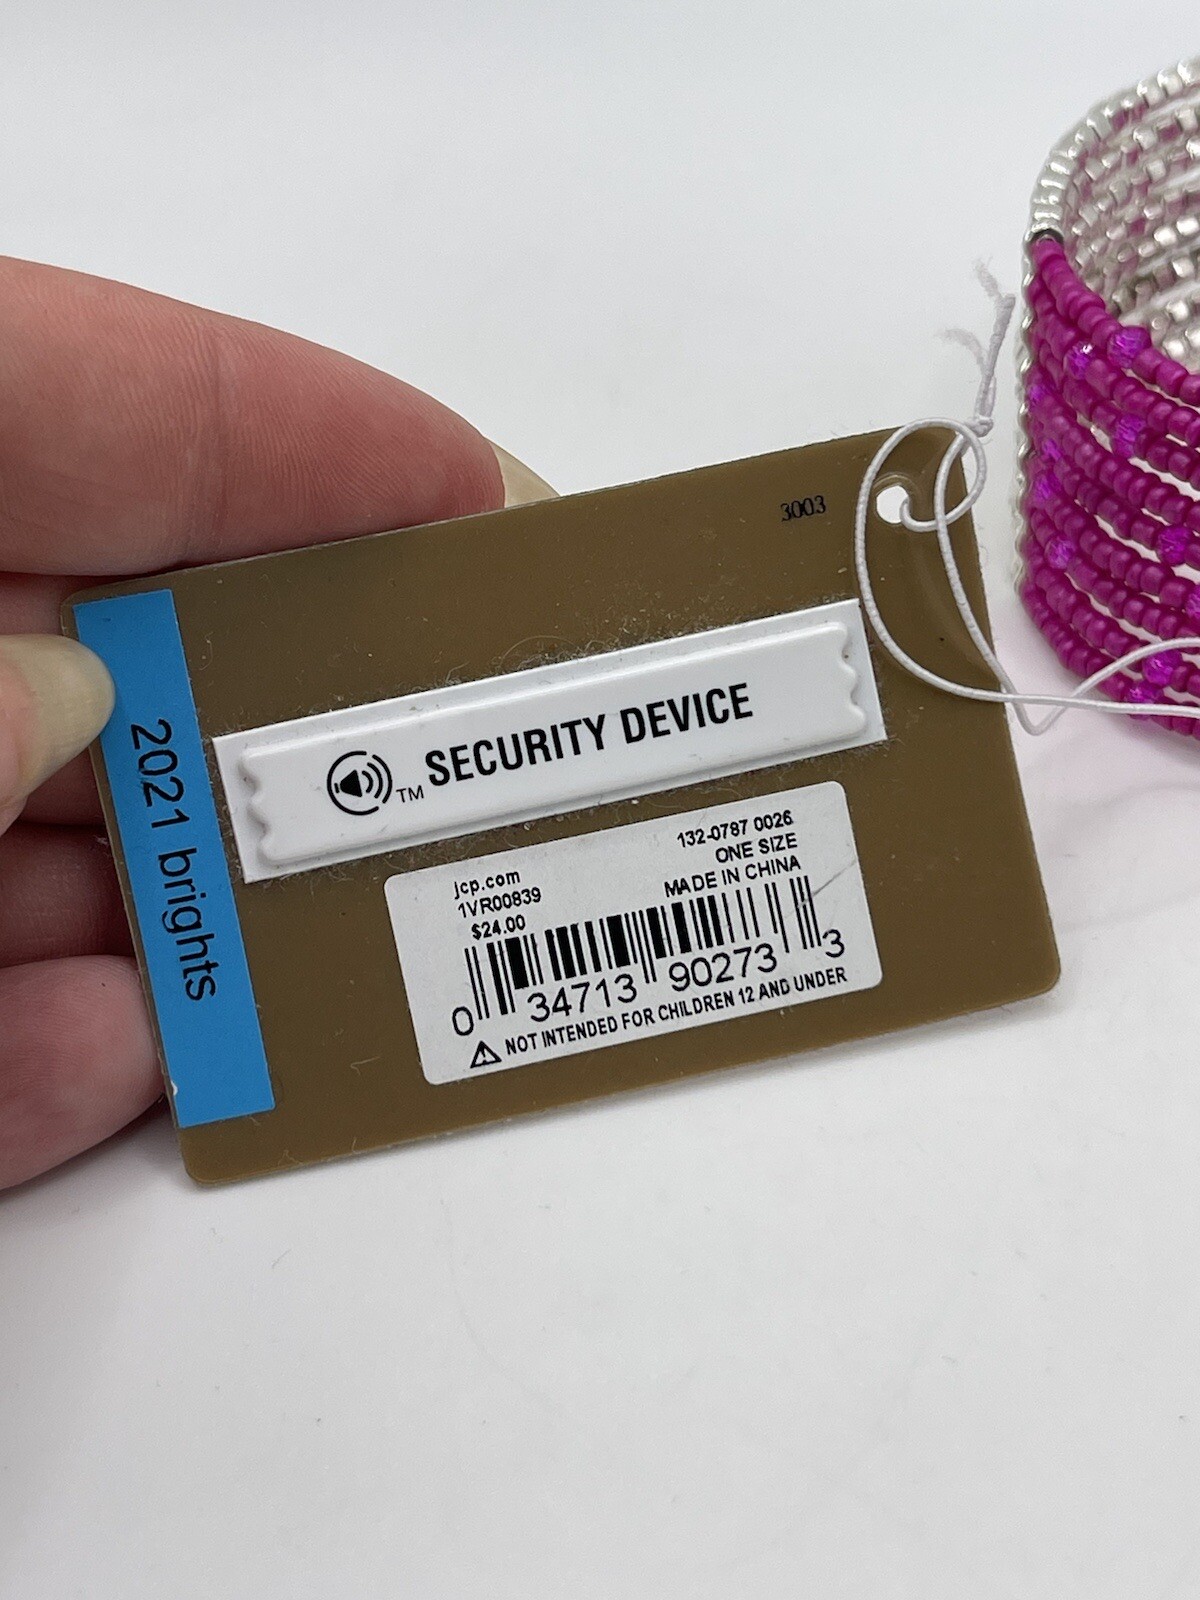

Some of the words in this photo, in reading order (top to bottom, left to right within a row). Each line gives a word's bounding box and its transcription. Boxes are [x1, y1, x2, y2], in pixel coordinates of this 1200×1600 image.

[780, 495, 827, 522] 3003
[424, 713, 606, 786] SECURITY
[620, 682, 753, 744] DEVICE
[130, 718, 191, 829] 2021
[396, 784, 425, 804] TM
[677, 820, 748, 849] 132-0787
[753, 809, 793, 832] 0026
[715, 842, 754, 864] ONE
[758, 832, 798, 857] SIZE
[454, 871, 521, 900] jcp.com
[664, 873, 718, 898] MADE
[722, 867, 741, 885] IN
[744, 855, 801, 881] CHINA
[458, 886, 542, 919] 1VR00839
[157, 846, 218, 1003] brights
[471, 914, 526, 940] $24.00
[452, 1006, 475, 1037] 0
[526, 973, 638, 1023] 34713
[668, 942, 778, 992] 90273
[822, 929, 846, 958] 3
[505, 1033, 538, 1056] NOT
[542, 1015, 618, 1048] INTENDED
[622, 1007, 655, 1029] FOR
[658, 990, 734, 1022] CHILDREN
[737, 984, 756, 1004] 12
[758, 977, 791, 1000] AND
[793, 966, 848, 993] UNDER
